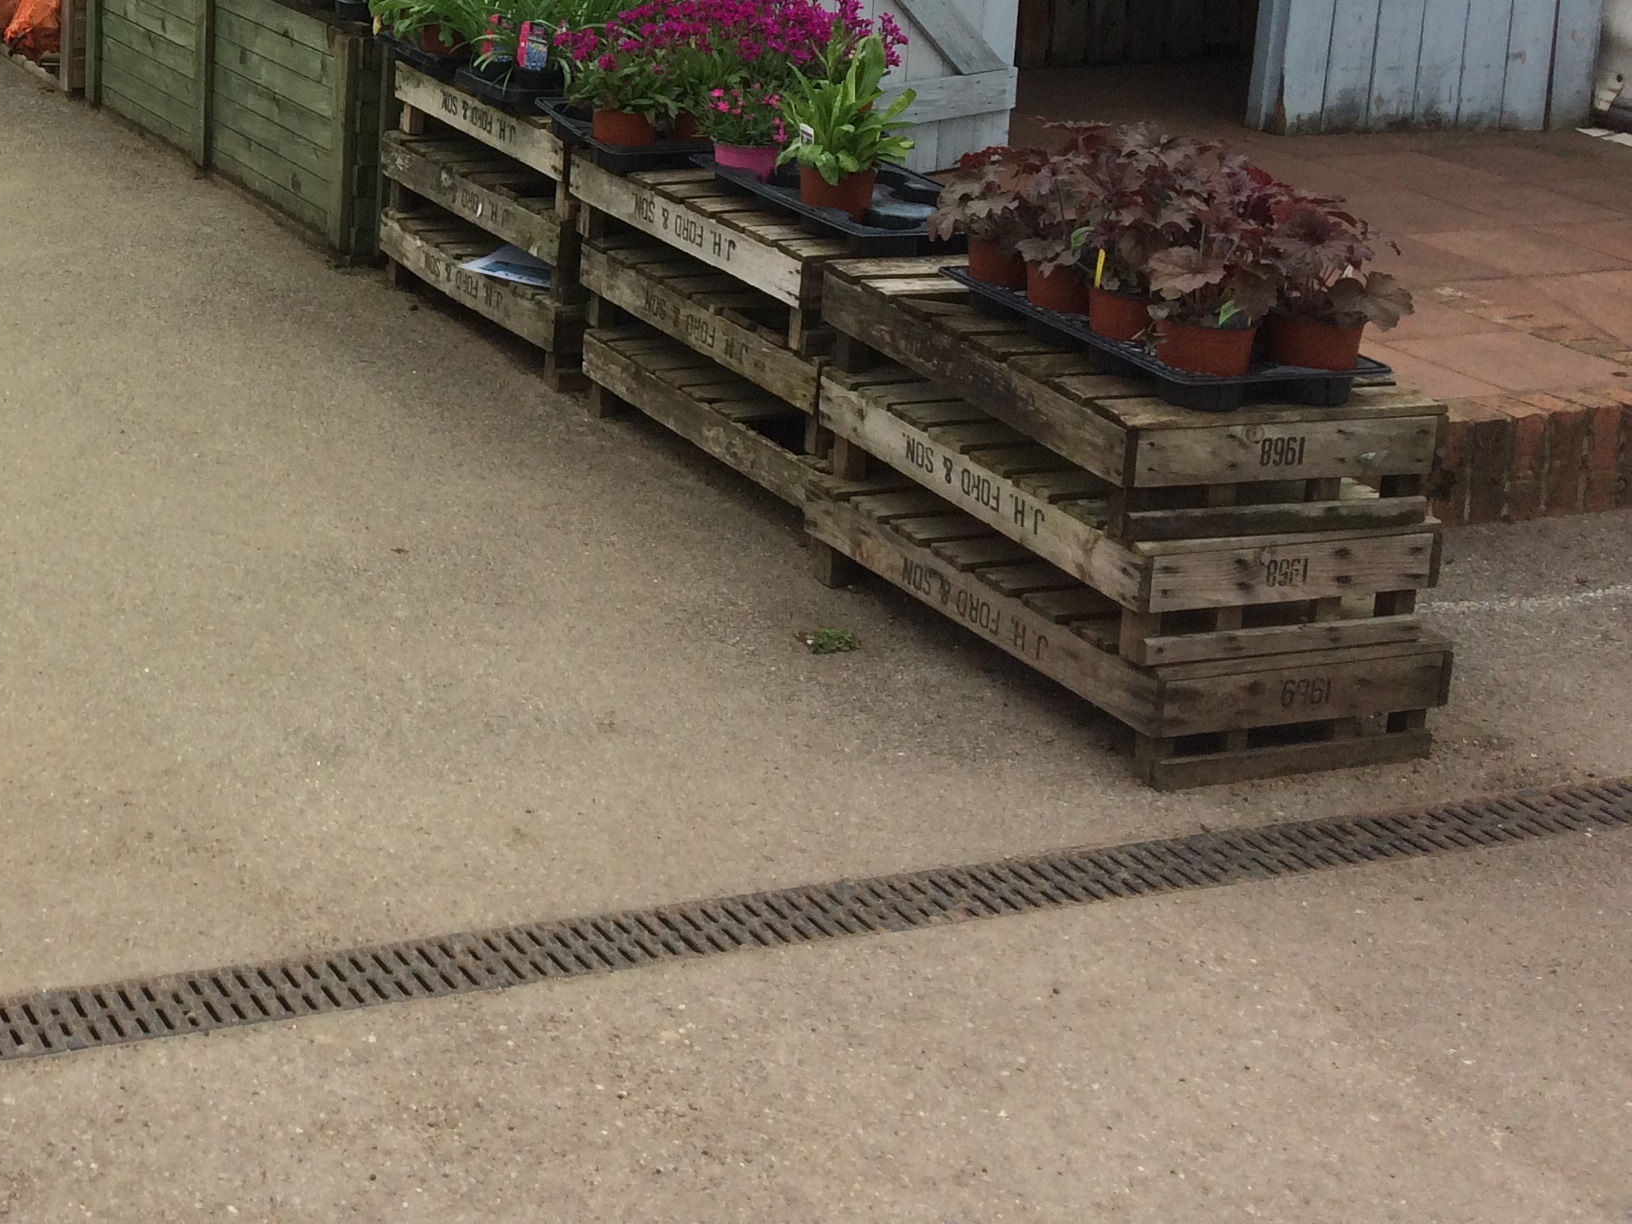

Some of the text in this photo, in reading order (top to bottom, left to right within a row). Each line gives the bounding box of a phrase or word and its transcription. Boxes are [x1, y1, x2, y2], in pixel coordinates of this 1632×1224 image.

[661, 206, 670, 230] &
[674, 214, 704, 248] FORD
[685, 313, 716, 349] FORD
[942, 454, 953, 484] &
[961, 468, 1001, 513] FORD
[956, 588, 1001, 635] FORD
